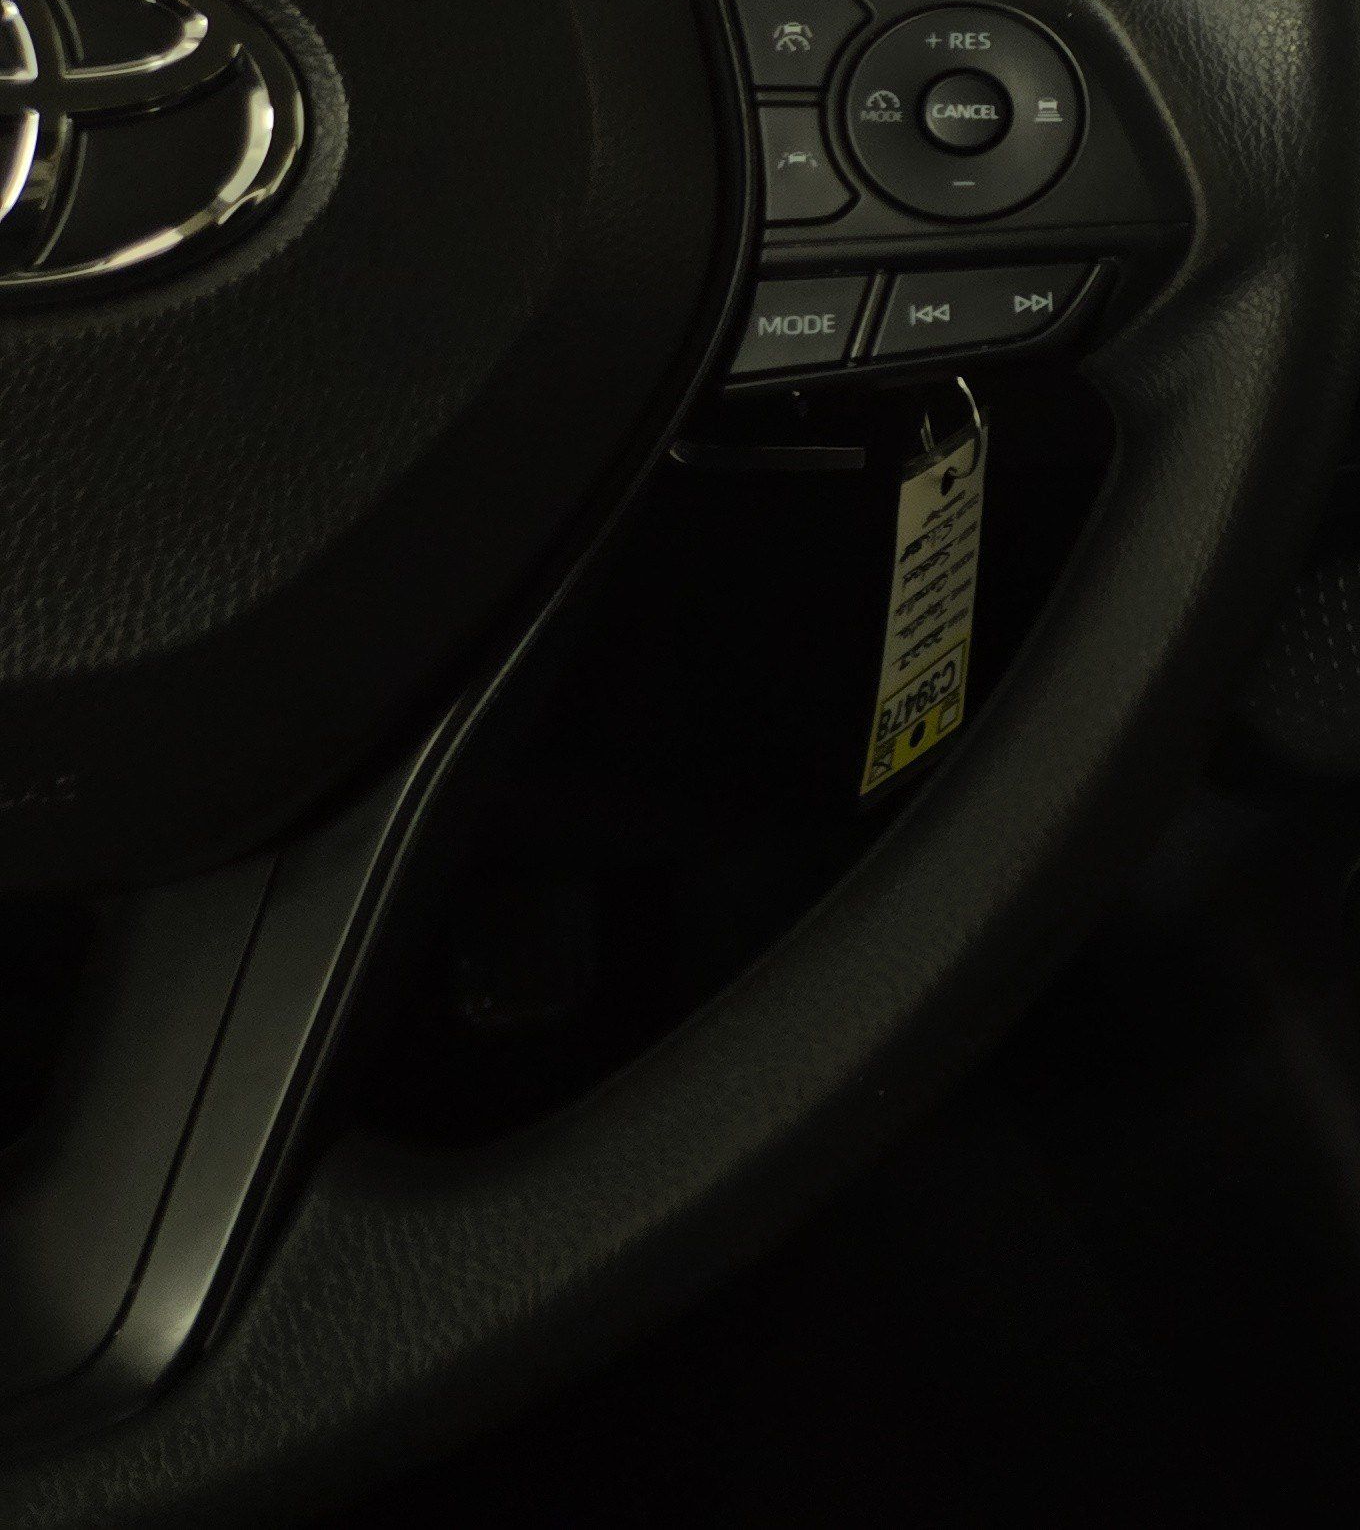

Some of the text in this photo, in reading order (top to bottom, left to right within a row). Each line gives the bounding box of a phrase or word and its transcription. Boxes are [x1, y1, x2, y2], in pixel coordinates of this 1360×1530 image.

[949, 32, 991, 49] RES
[860, 110, 902, 123] MODE
[931, 103, 999, 120] CANCEL
[758, 312, 837, 337] MODE
